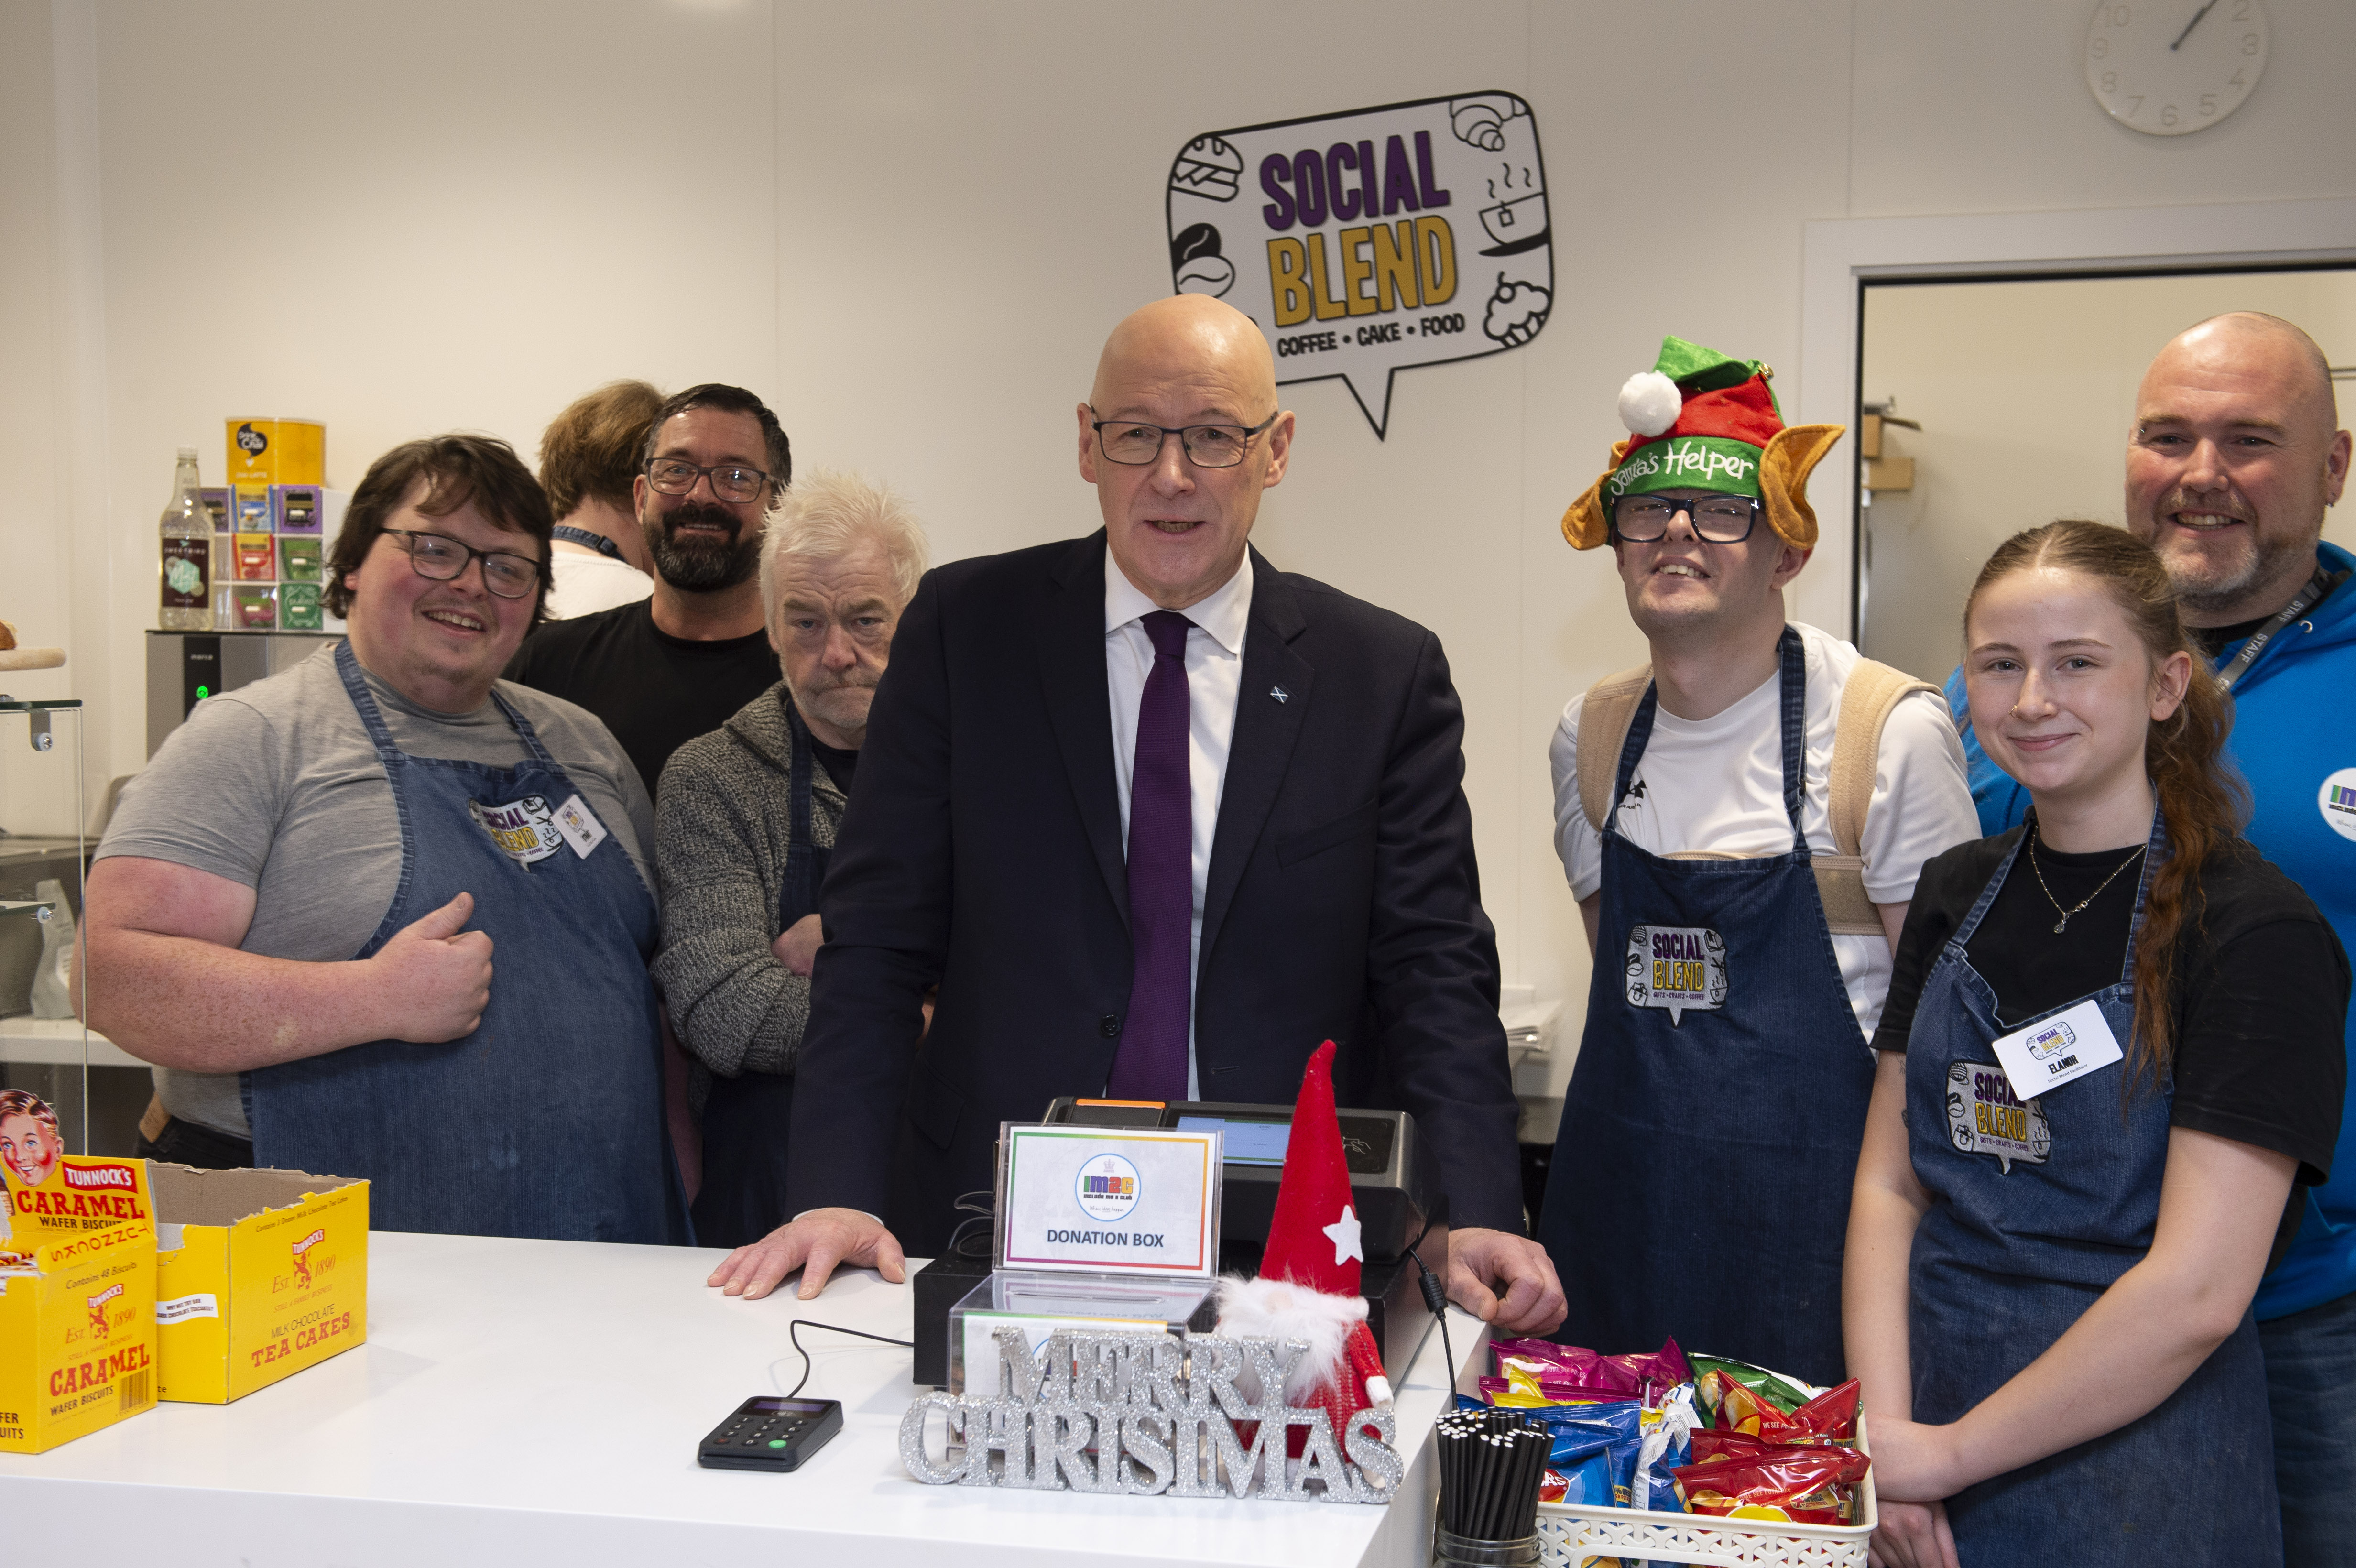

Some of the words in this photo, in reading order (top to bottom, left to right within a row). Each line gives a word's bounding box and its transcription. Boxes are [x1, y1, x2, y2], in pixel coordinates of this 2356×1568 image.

[1259, 131, 1450, 231] SOCIAL
[1267, 215, 1457, 327] BLEND
[1277, 331, 1337, 357] COFFEE
[1357, 323, 1401, 346] CAKE
[1420, 313, 1465, 336] FOOD
[1610, 452, 1659, 495] Santa's
[1663, 441, 1754, 481] Helper
[2277, 600, 2304, 622] STAFF
[2241, 633, 2268, 663] STAFF
[1652, 933, 1705, 960] SOCIAL
[1653, 960, 1704, 991] BLEND
[2037, 1028, 2060, 1044] SOCIAL
[2040, 1034, 2064, 1052] BLEND
[2048, 1055, 2079, 1074] ELANOR
[2070, 1064, 2088, 1074] Facilitator
[1975, 1102, 2027, 1142] BLEND
[1995, 1139, 2011, 1148] CRAFTS
[65, 1167, 132, 1186] TUNNOCK'S
[17, 1190, 145, 1219] CARAMEL
[39, 1216, 77, 1228] WAFER
[1047, 1229, 1128, 1246] DONATION
[1133, 1233, 1164, 1248] BOX
[66, 1272, 99, 1289] Contains
[111, 1261, 138, 1275] Biscuits
[315, 1254, 336, 1278] 1890
[113, 1306, 137, 1328] 1890
[271, 1325, 290, 1339] MILK
[291, 1304, 335, 1331] CHOCOLATE
[251, 1338, 291, 1368] TEA
[296, 1311, 351, 1350] CAKES
[50, 1343, 150, 1397] CARAMEL
[992, 1325, 1311, 1414] MERRY
[50, 1398, 77, 1416] WAFER
[81, 1385, 114, 1405] BISCUITS
[1765, 1405, 1779, 1414] SOME
[0, 1412, 19, 1424] FER
[899, 1390, 1405, 1504] CHRISTMAS
